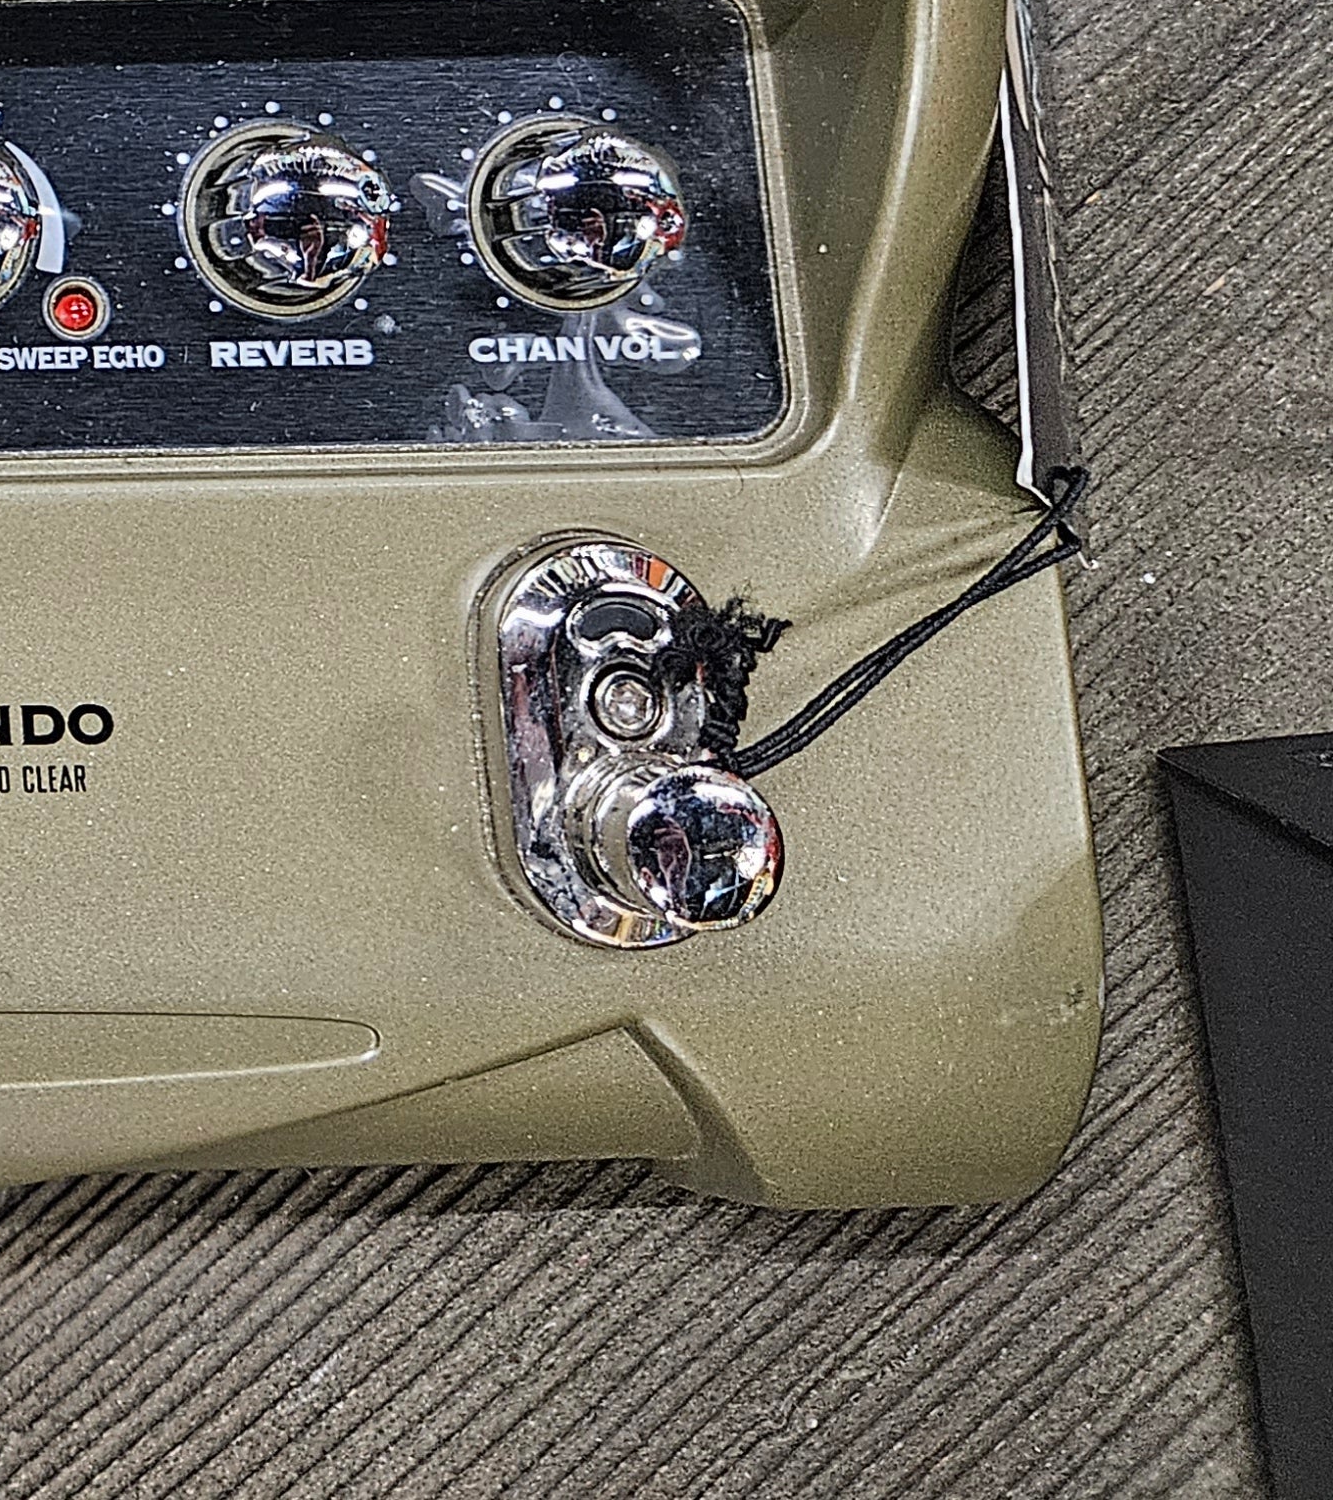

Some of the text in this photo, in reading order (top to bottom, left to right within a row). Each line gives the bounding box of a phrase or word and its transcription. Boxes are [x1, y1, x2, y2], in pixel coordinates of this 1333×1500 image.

[93, 345, 165, 369] ECHO
[210, 338, 374, 368] REVERB
[468, 335, 679, 363] CHAN VOL
[22, 765, 87, 793] CLEAR
